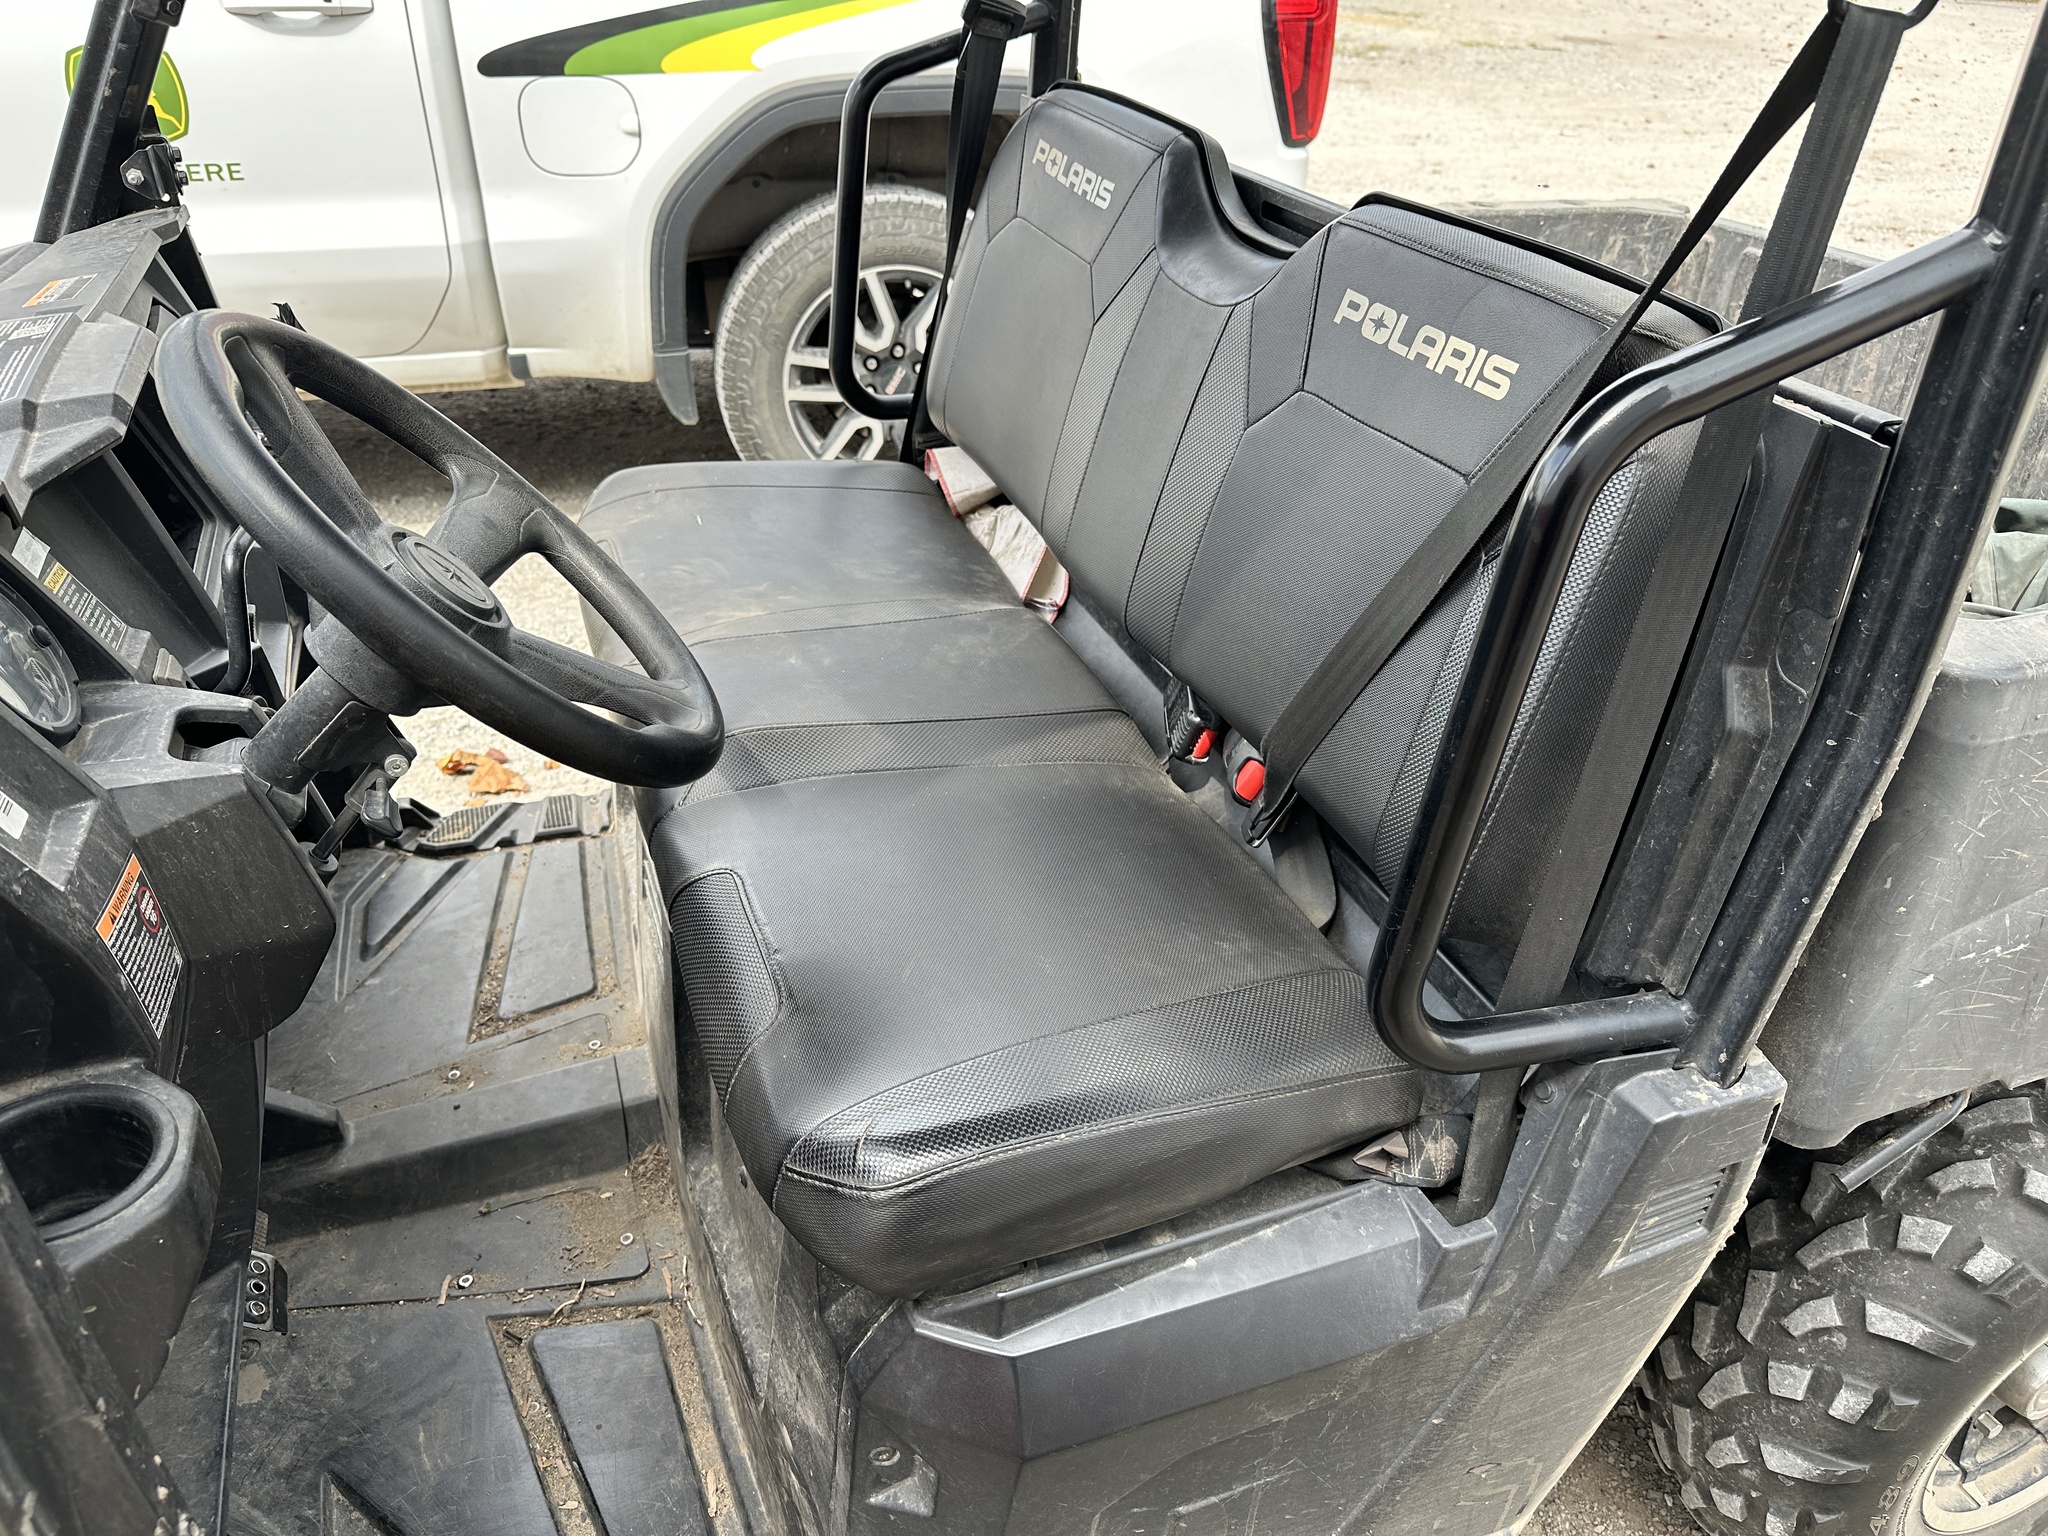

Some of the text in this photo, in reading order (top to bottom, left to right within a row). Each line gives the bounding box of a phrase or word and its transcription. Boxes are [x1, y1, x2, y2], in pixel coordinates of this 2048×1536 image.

[177, 163, 245, 181] ERE
[1032, 138, 1115, 210] POLARIS
[1333, 288, 1520, 401] POLARIS
[112, 872, 135, 914] WARNING
